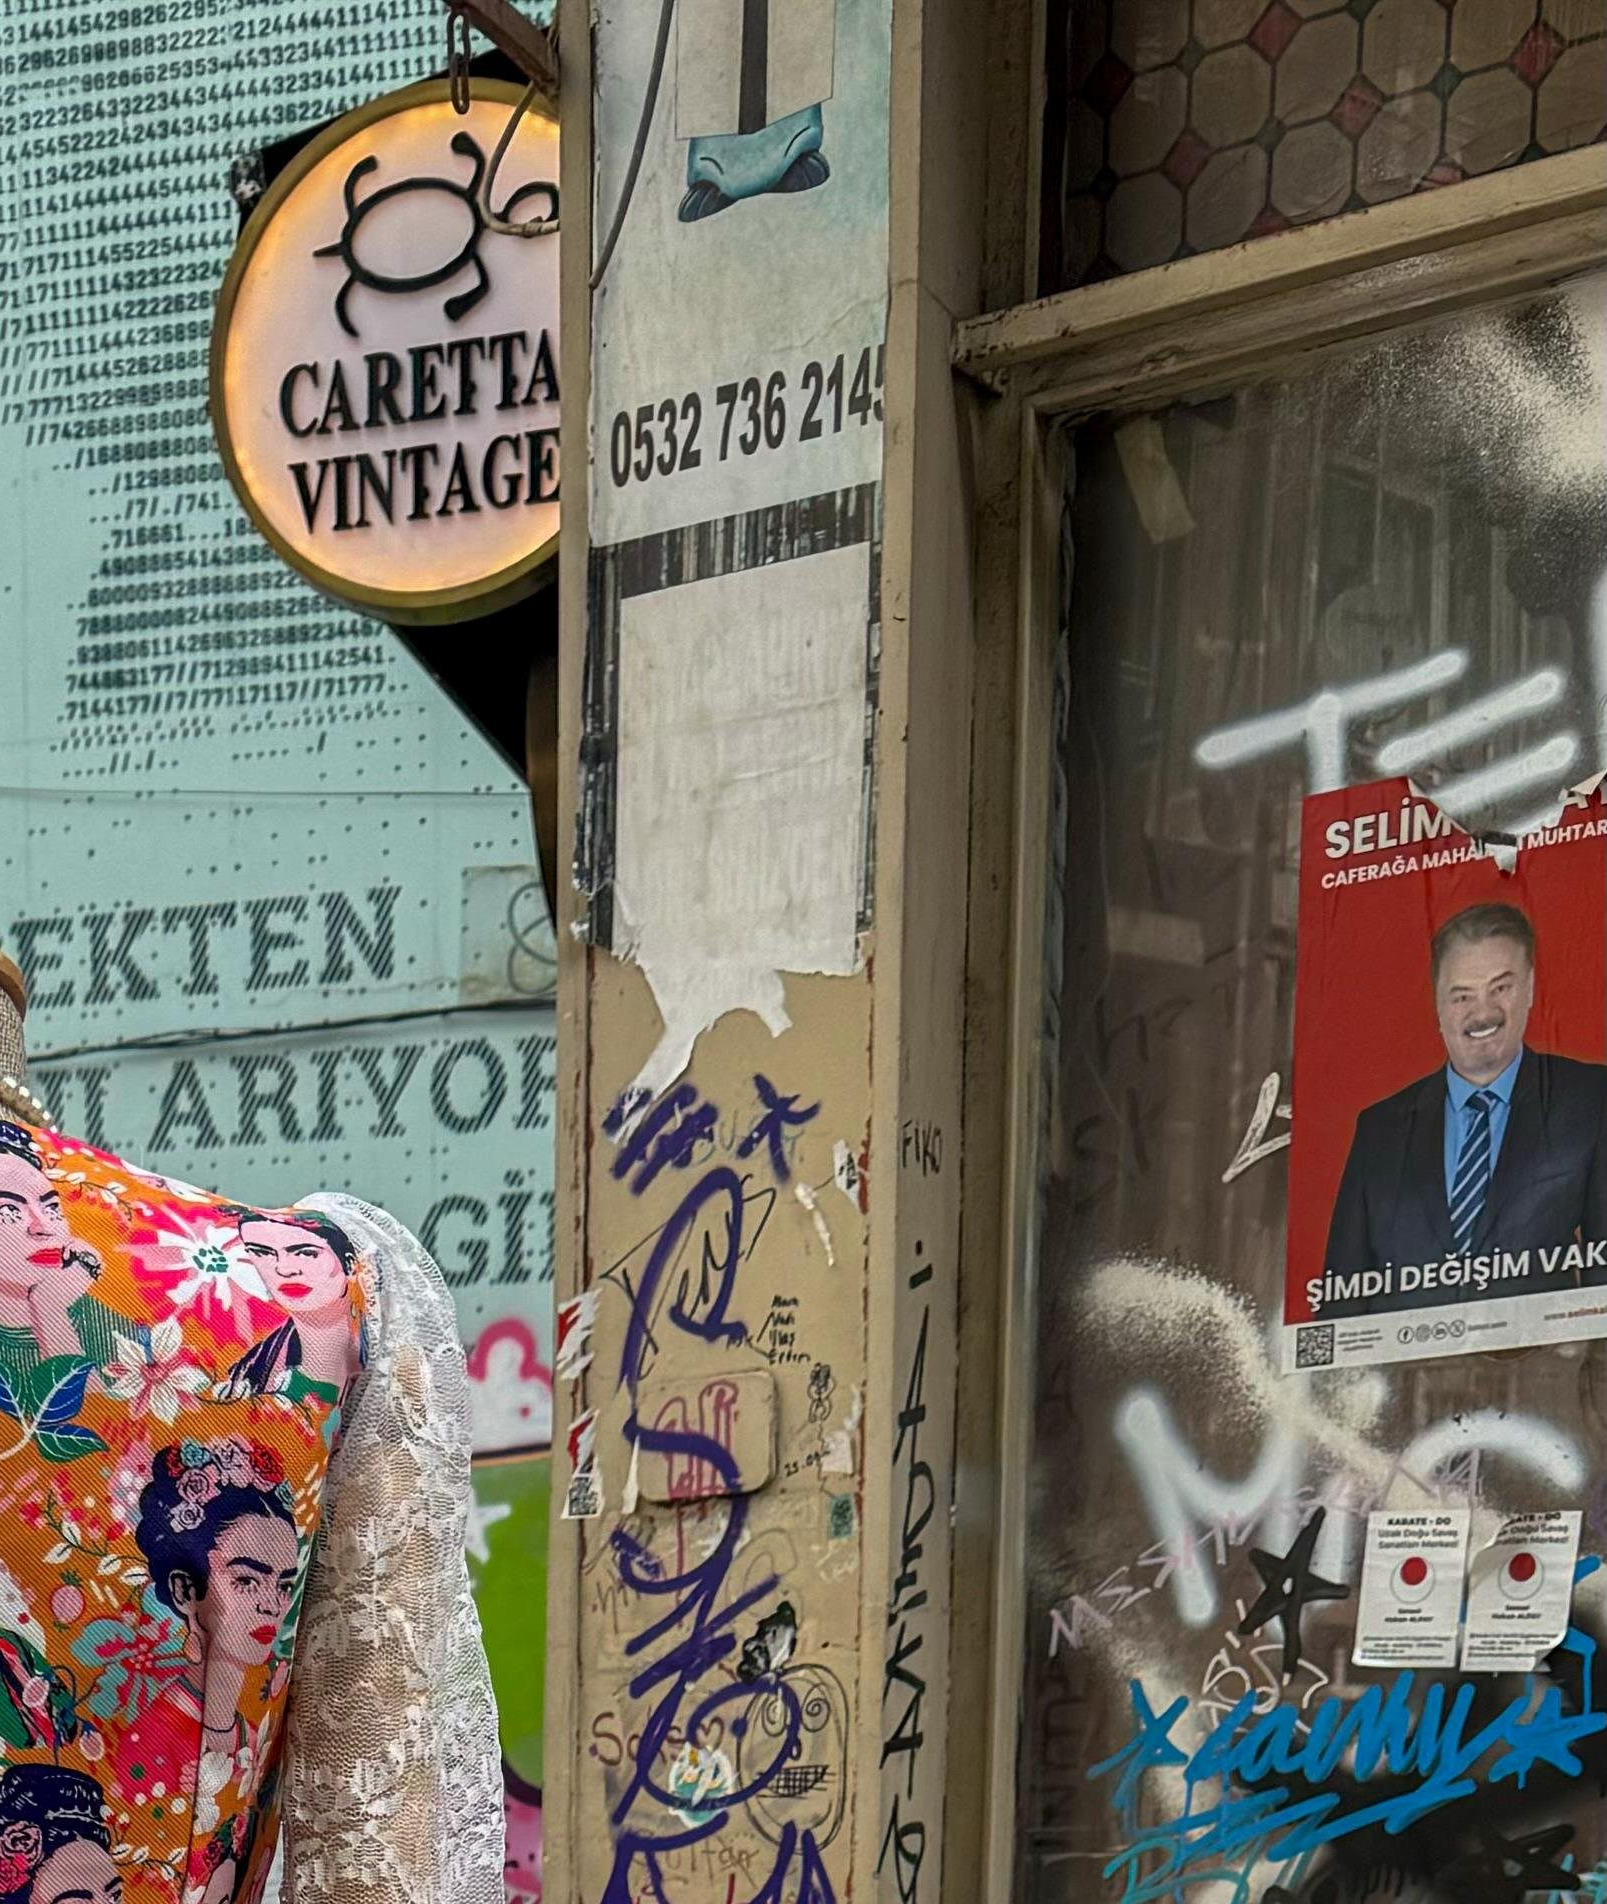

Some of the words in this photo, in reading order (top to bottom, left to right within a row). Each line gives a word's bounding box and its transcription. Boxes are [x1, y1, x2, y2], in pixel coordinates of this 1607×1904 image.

[280, 328, 559, 439] CARETTA
[611, 391, 703, 489] 0532
[716, 372, 787, 464] 736
[289, 428, 559, 534] VINTAGE
[1325, 797, 1453, 860] SELİM
[1321, 856, 1419, 890] CAFERAĞA
[1306, 1262, 1392, 1312] ŞİMDİ
[1400, 1247, 1531, 1293] DEĞİŞİM
